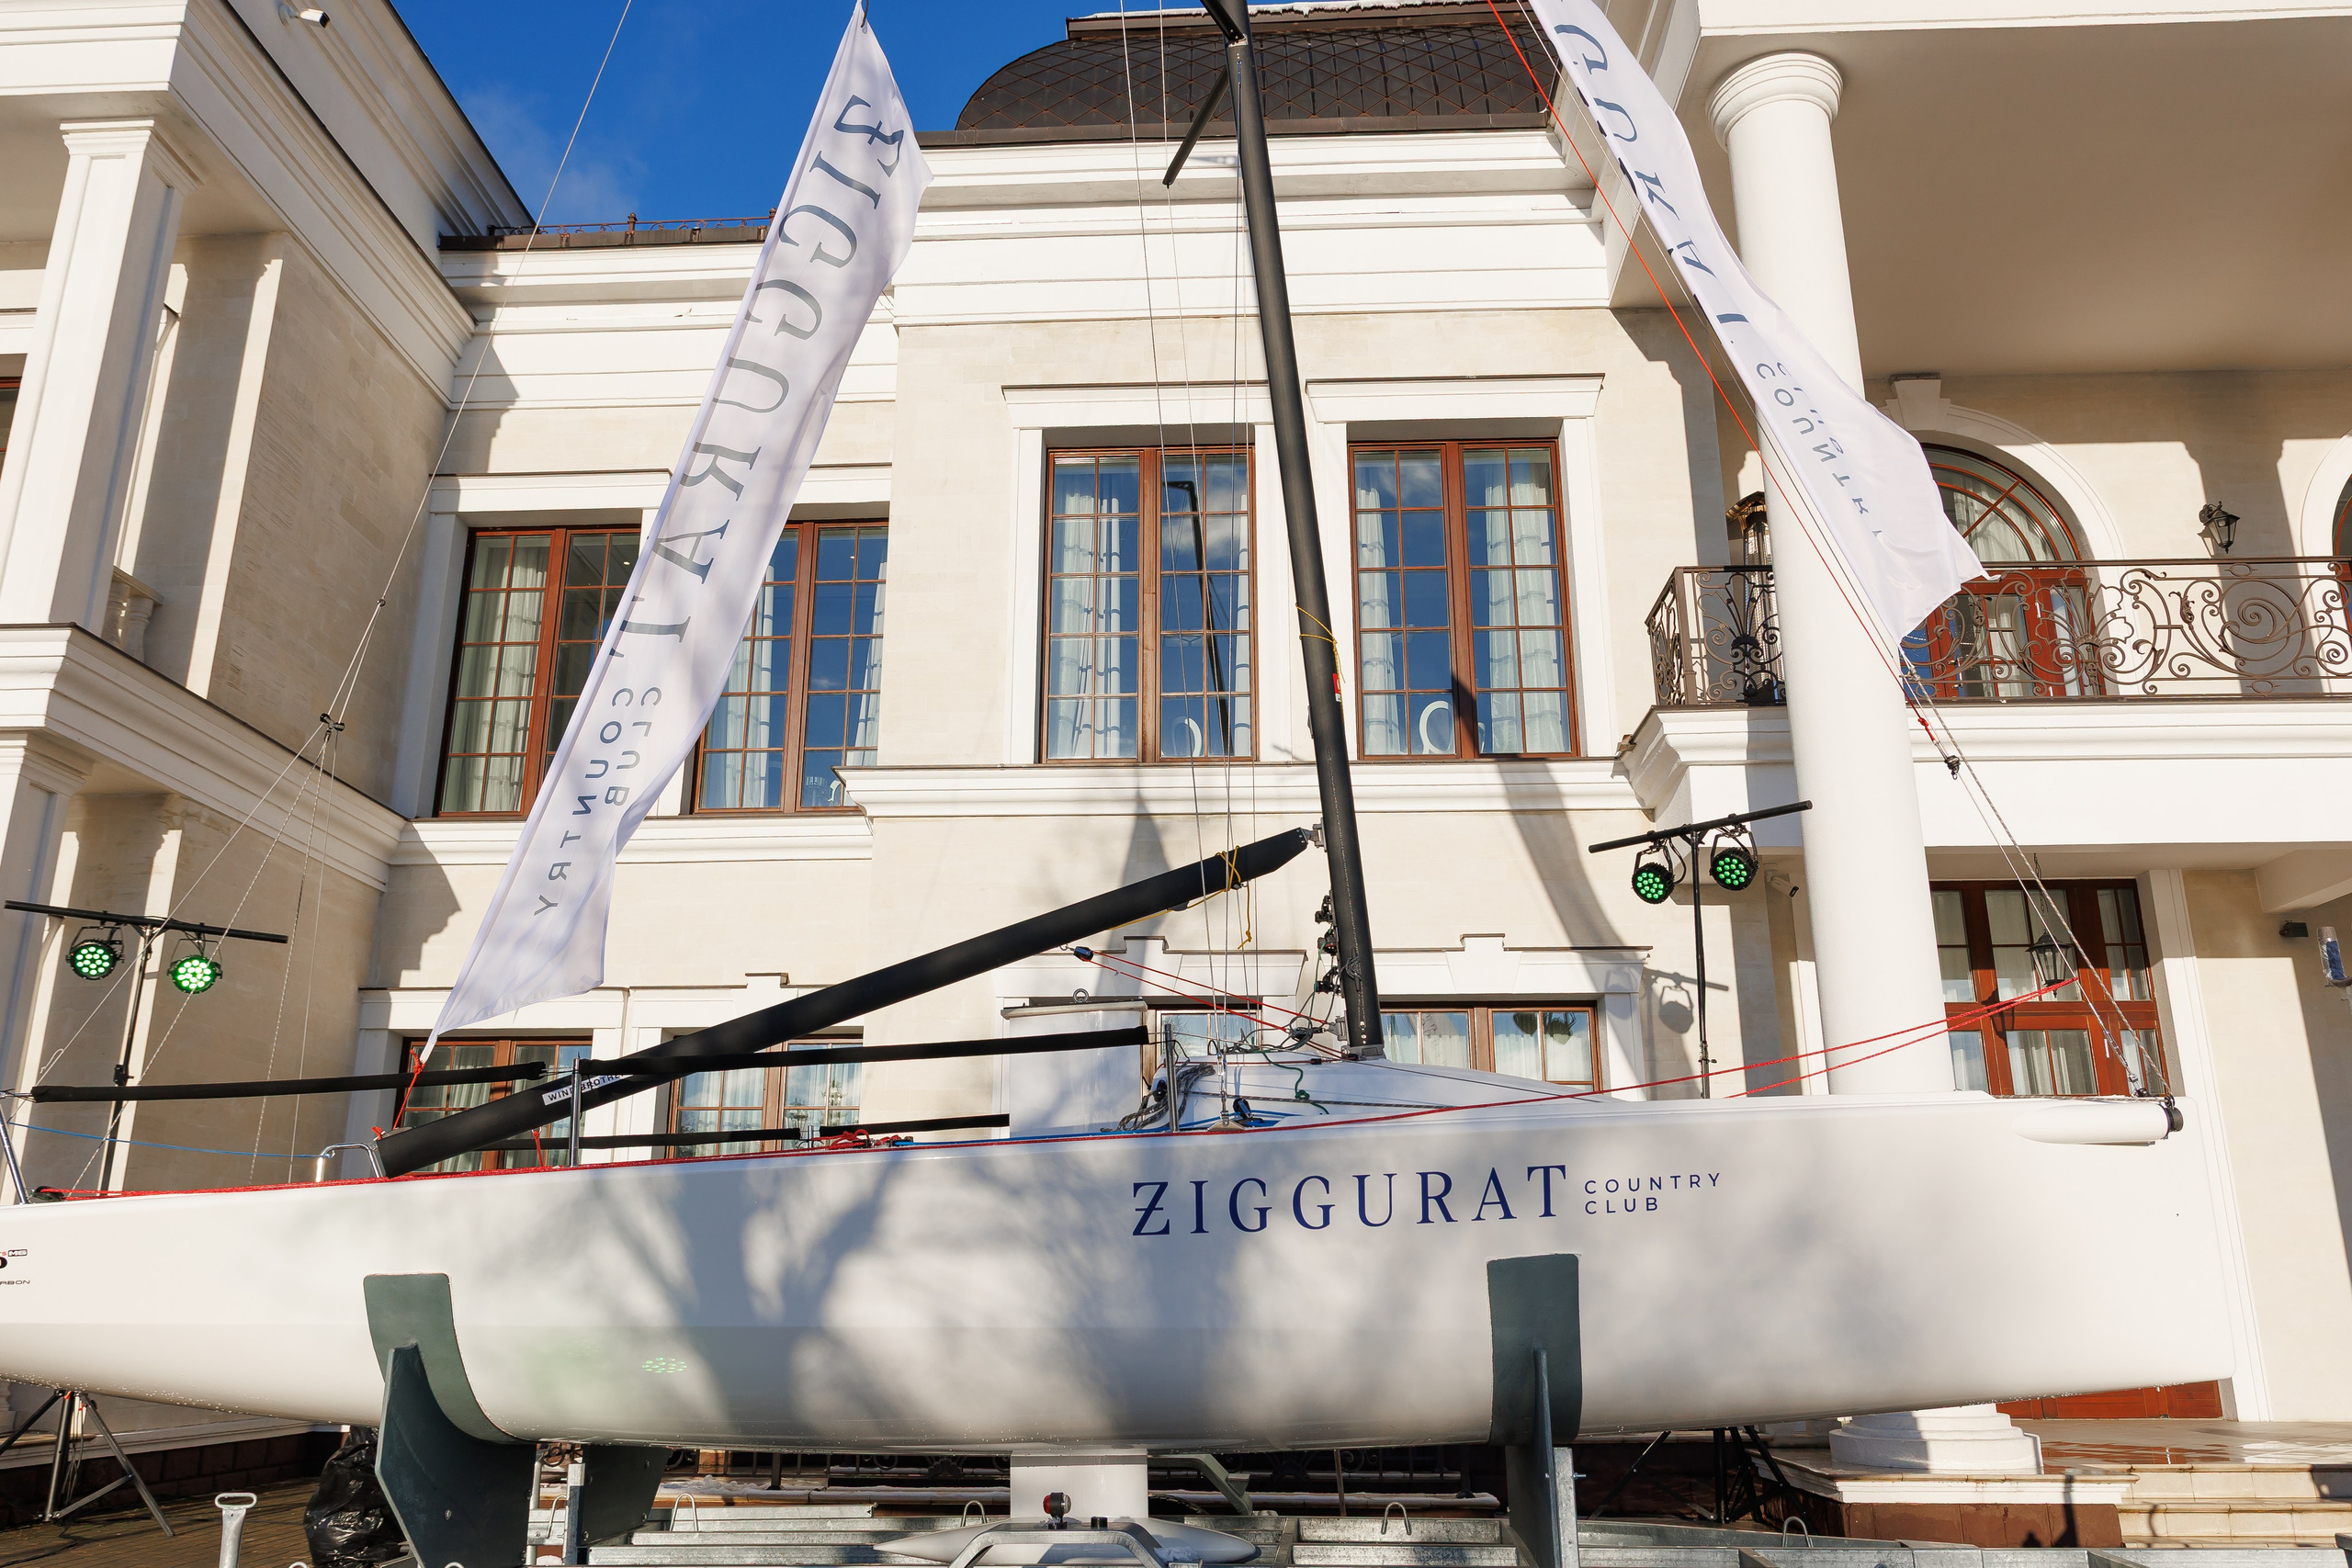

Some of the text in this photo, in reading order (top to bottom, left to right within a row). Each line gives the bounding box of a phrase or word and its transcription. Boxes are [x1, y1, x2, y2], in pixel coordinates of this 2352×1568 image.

[1584, 1173, 1720, 1194] COUNTRY
[1133, 1165, 1566, 1235] ZIGGURAT
[1585, 1197, 1658, 1214] CLUB
